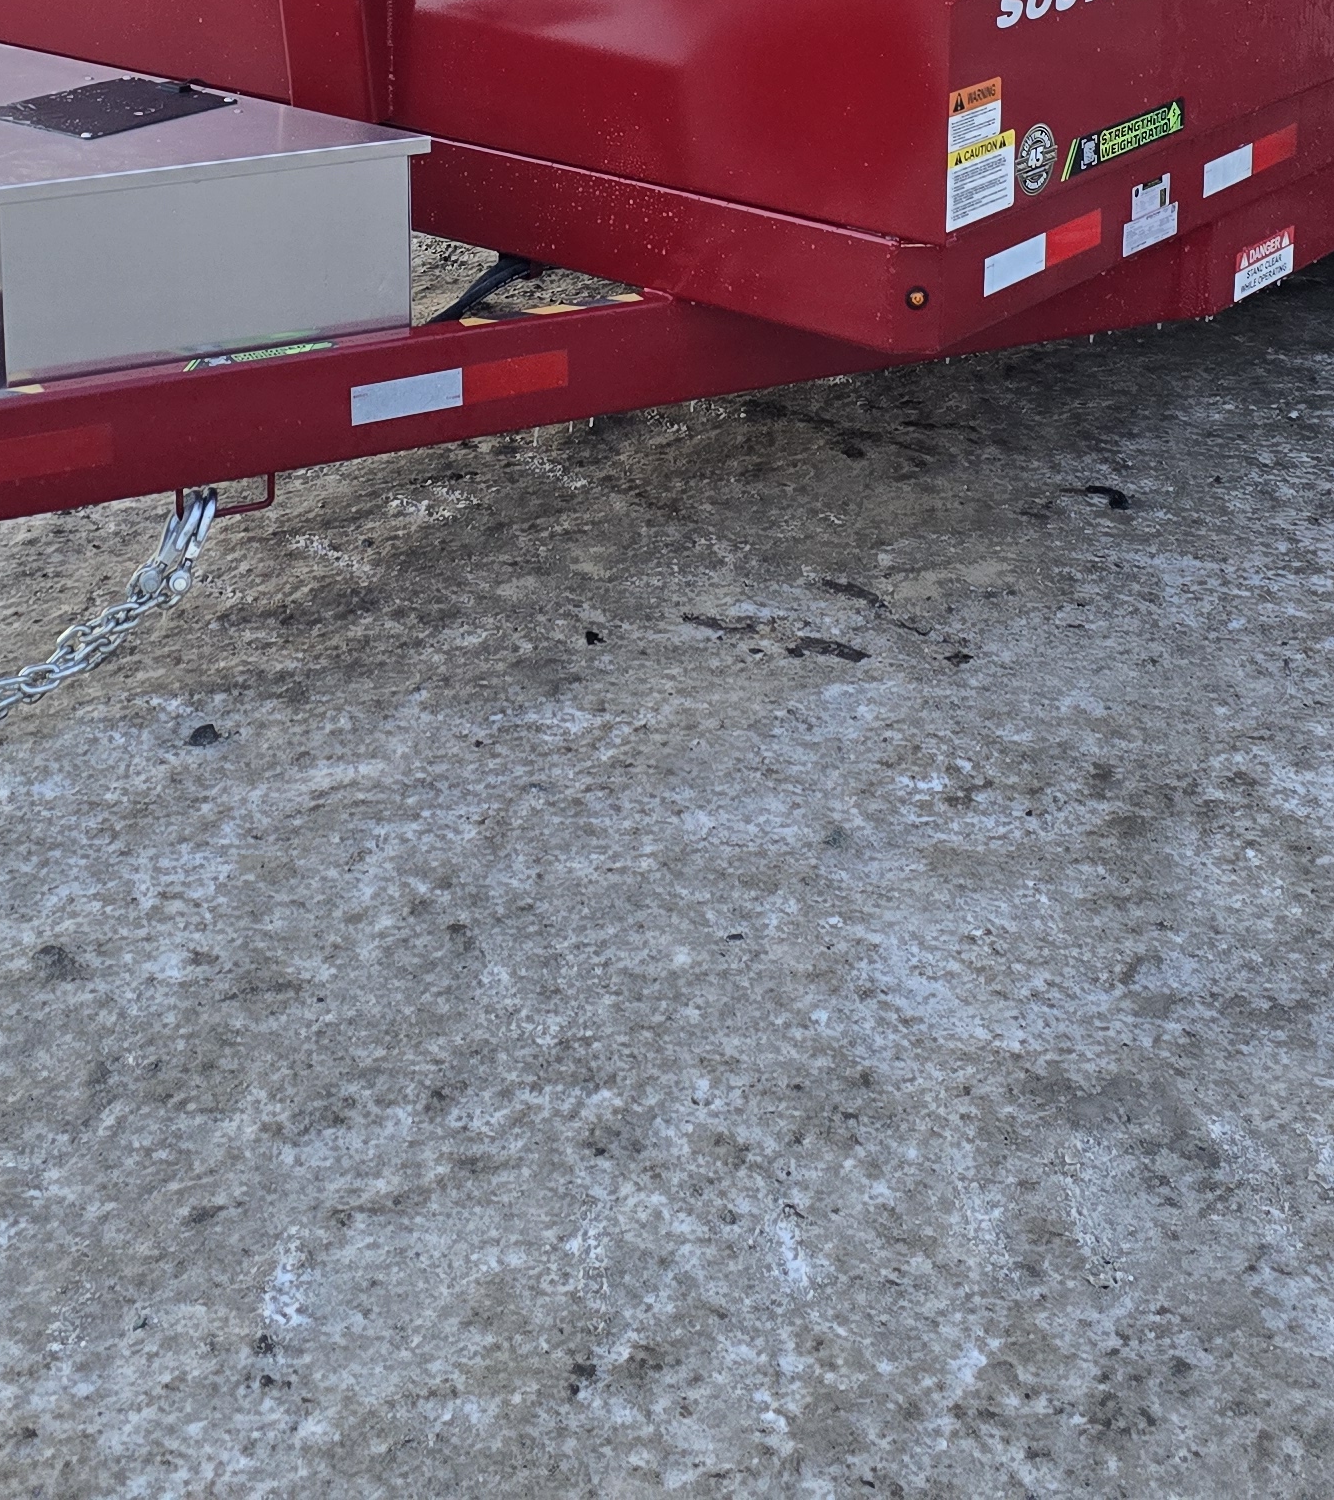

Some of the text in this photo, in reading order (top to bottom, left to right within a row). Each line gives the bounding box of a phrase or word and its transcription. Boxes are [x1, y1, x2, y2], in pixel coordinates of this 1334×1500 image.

[967, 84, 996, 105] WARNING
[963, 139, 998, 162] CAUTION
[1101, 121, 1168, 159] WEIGHT RATIO
[1028, 146, 1044, 169] 45
[1249, 236, 1281, 264] DANGER
[1240, 263, 1288, 294] WHILE OPERATING
[1246, 254, 1283, 279] STAND CLEAR
